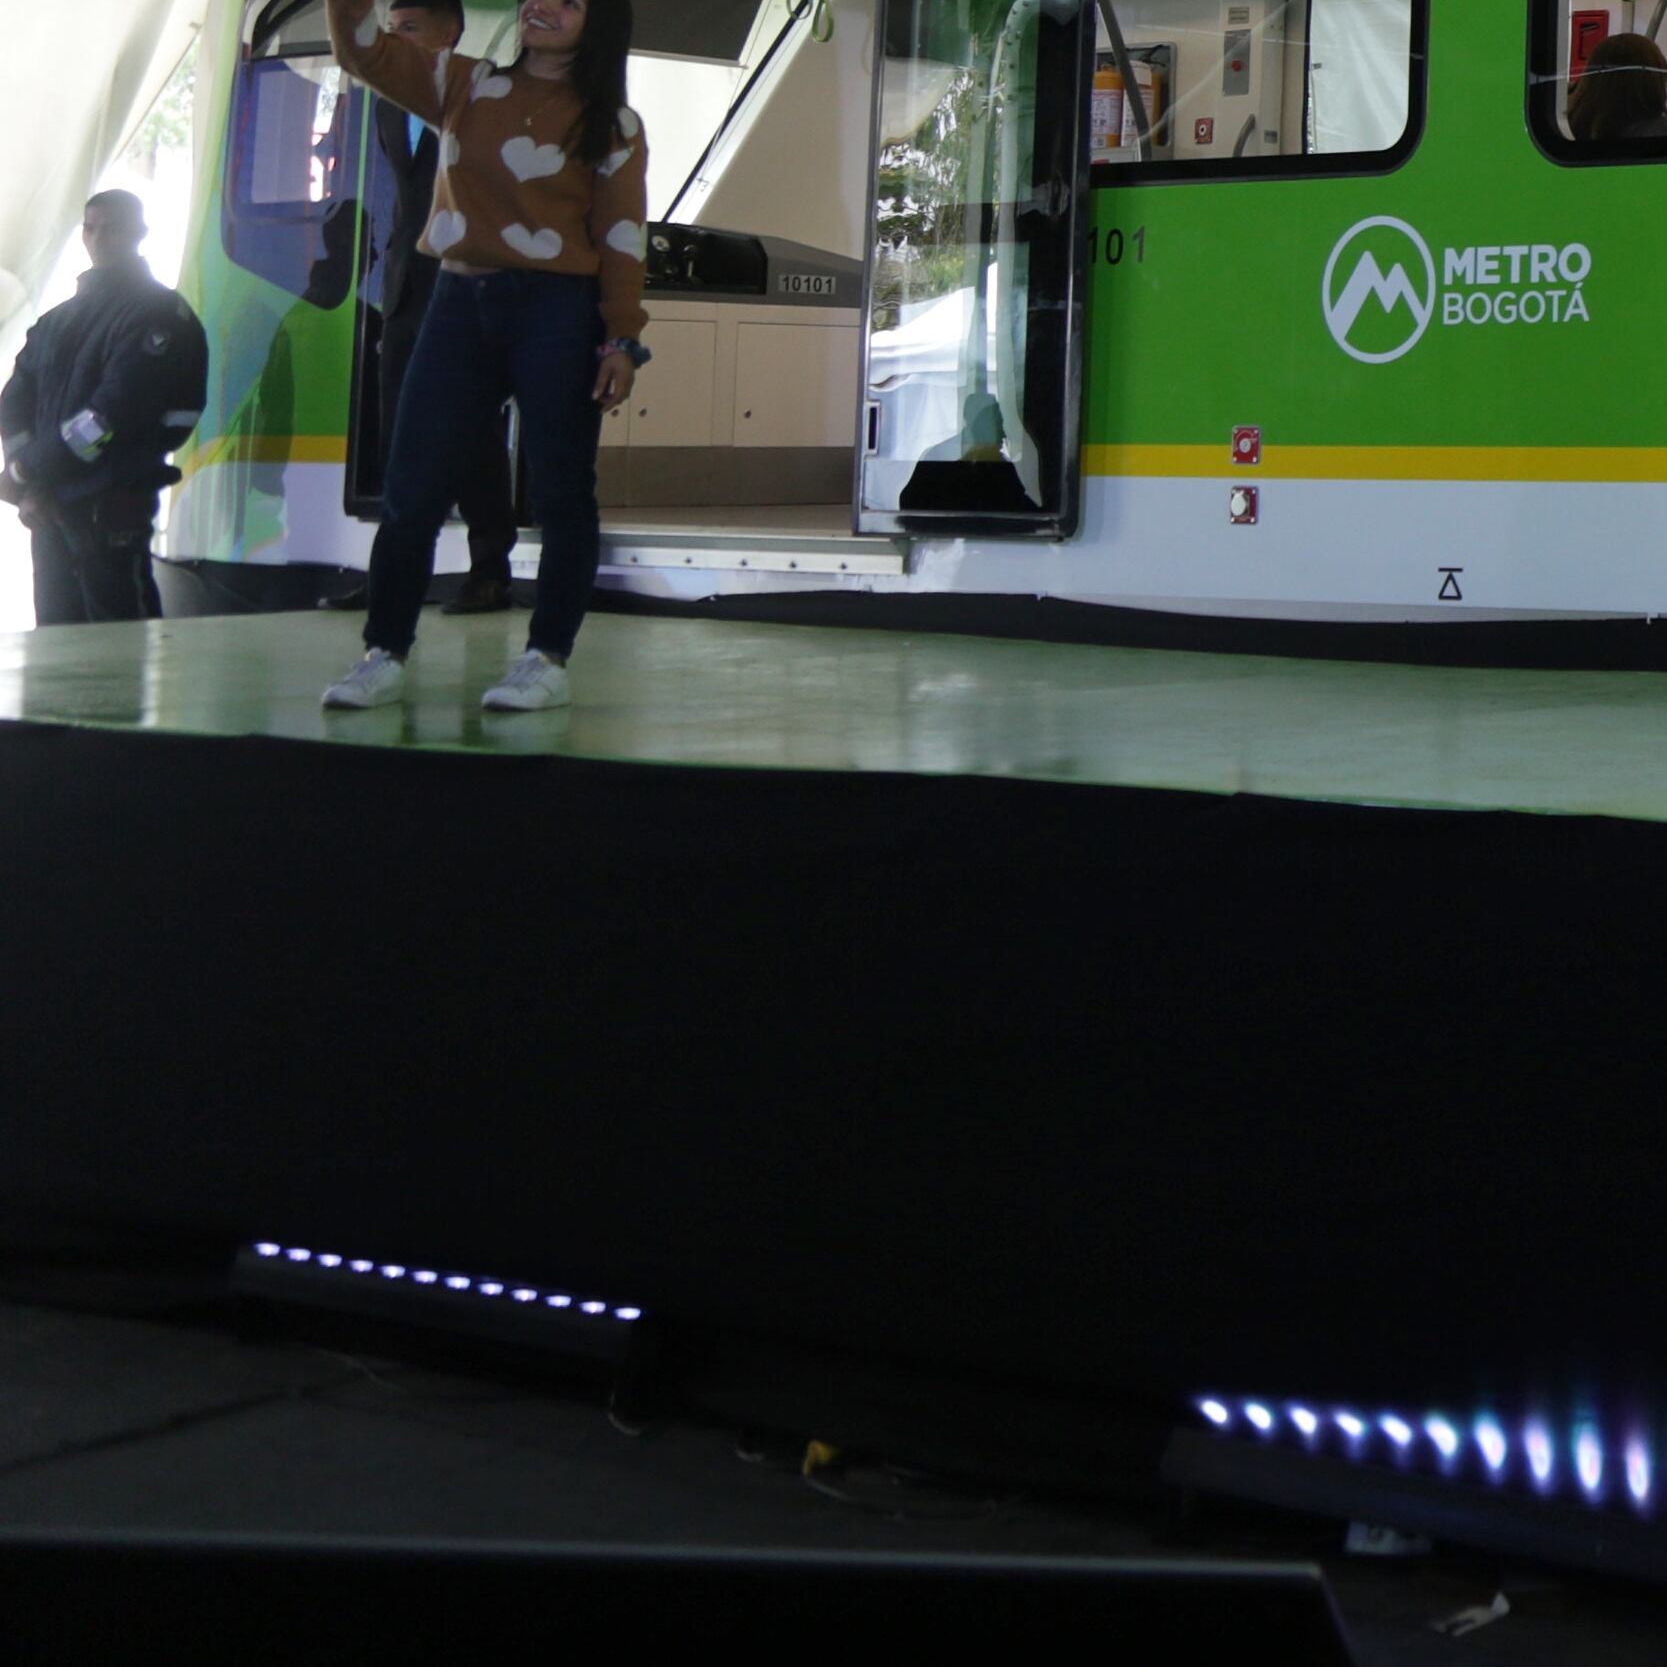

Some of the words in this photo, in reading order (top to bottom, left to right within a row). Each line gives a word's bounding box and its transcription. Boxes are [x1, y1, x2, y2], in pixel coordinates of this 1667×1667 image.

[783, 276, 832, 293] 10101
[1444, 242, 1592, 285] METRO
[1442, 282, 1590, 325] BOGOTÁ
